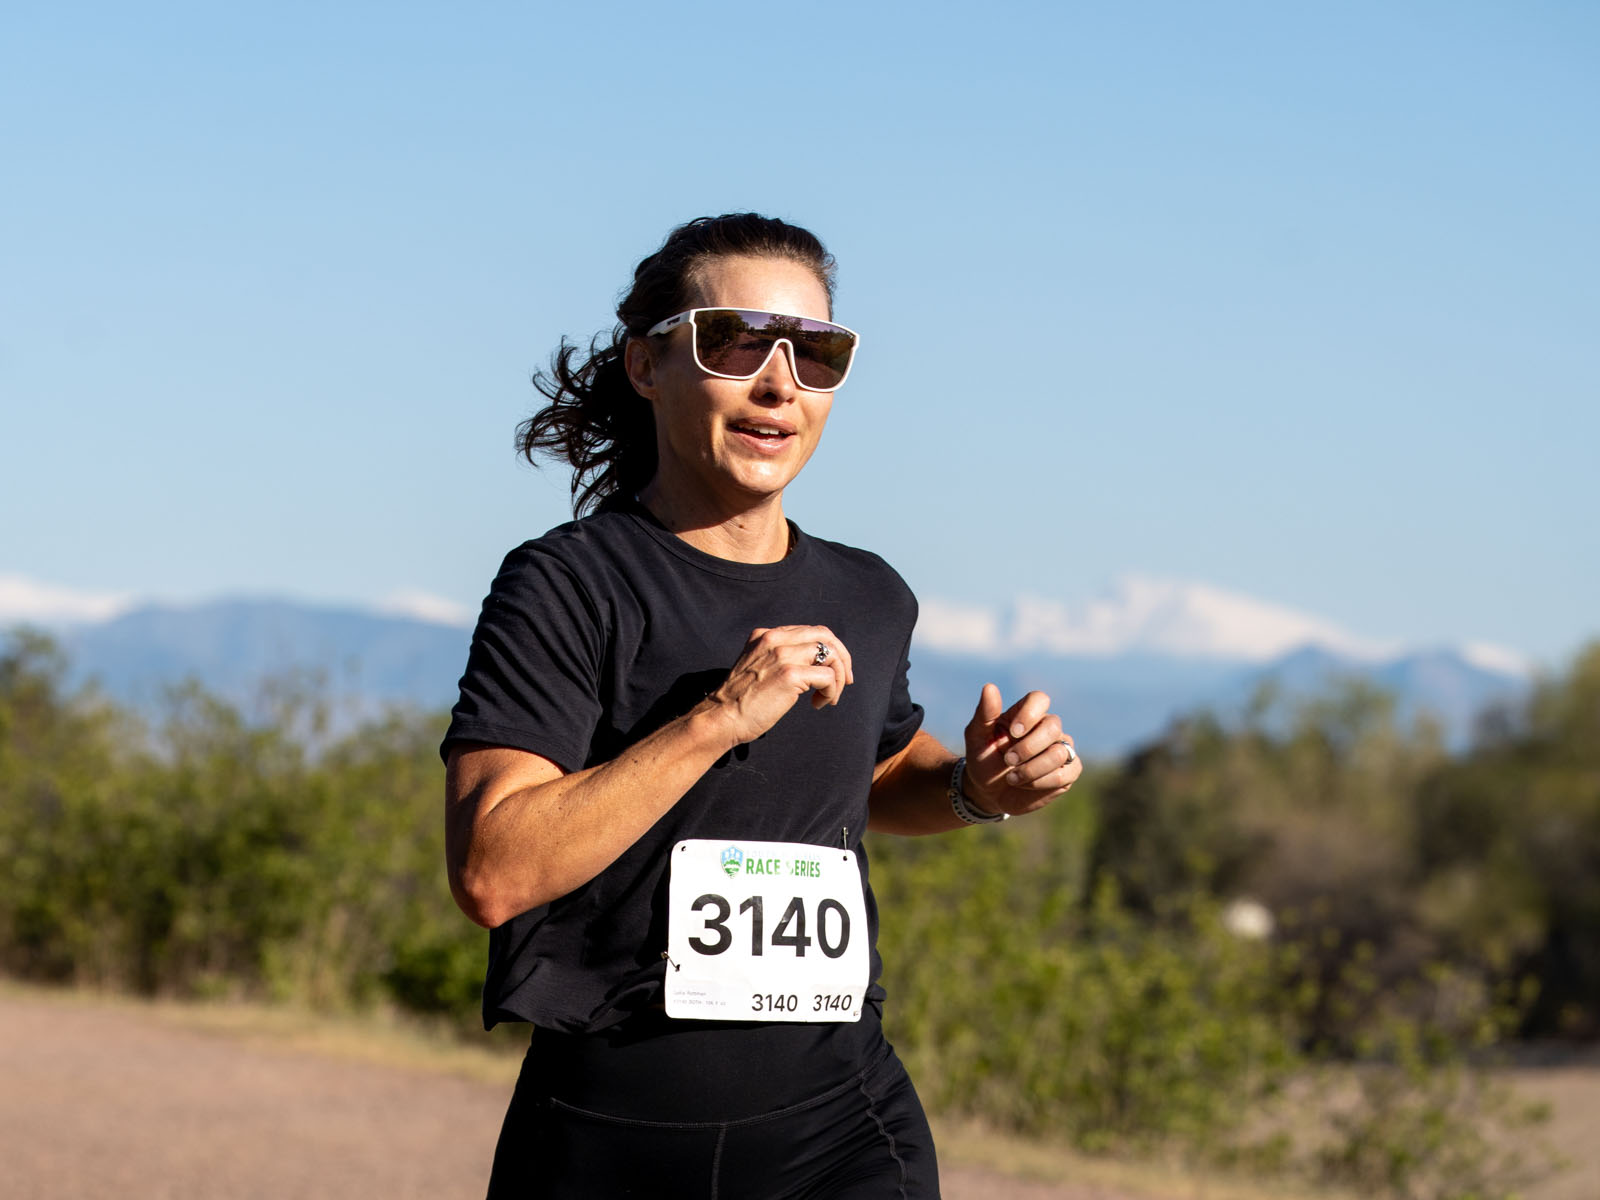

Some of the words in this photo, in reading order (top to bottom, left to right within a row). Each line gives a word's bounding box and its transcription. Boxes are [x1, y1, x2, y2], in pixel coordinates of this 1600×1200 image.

[745, 857, 782, 875] RACE
[688, 893, 851, 959] 3140
[751, 993, 798, 1012] 3140
[812, 994, 853, 1011] 3140
